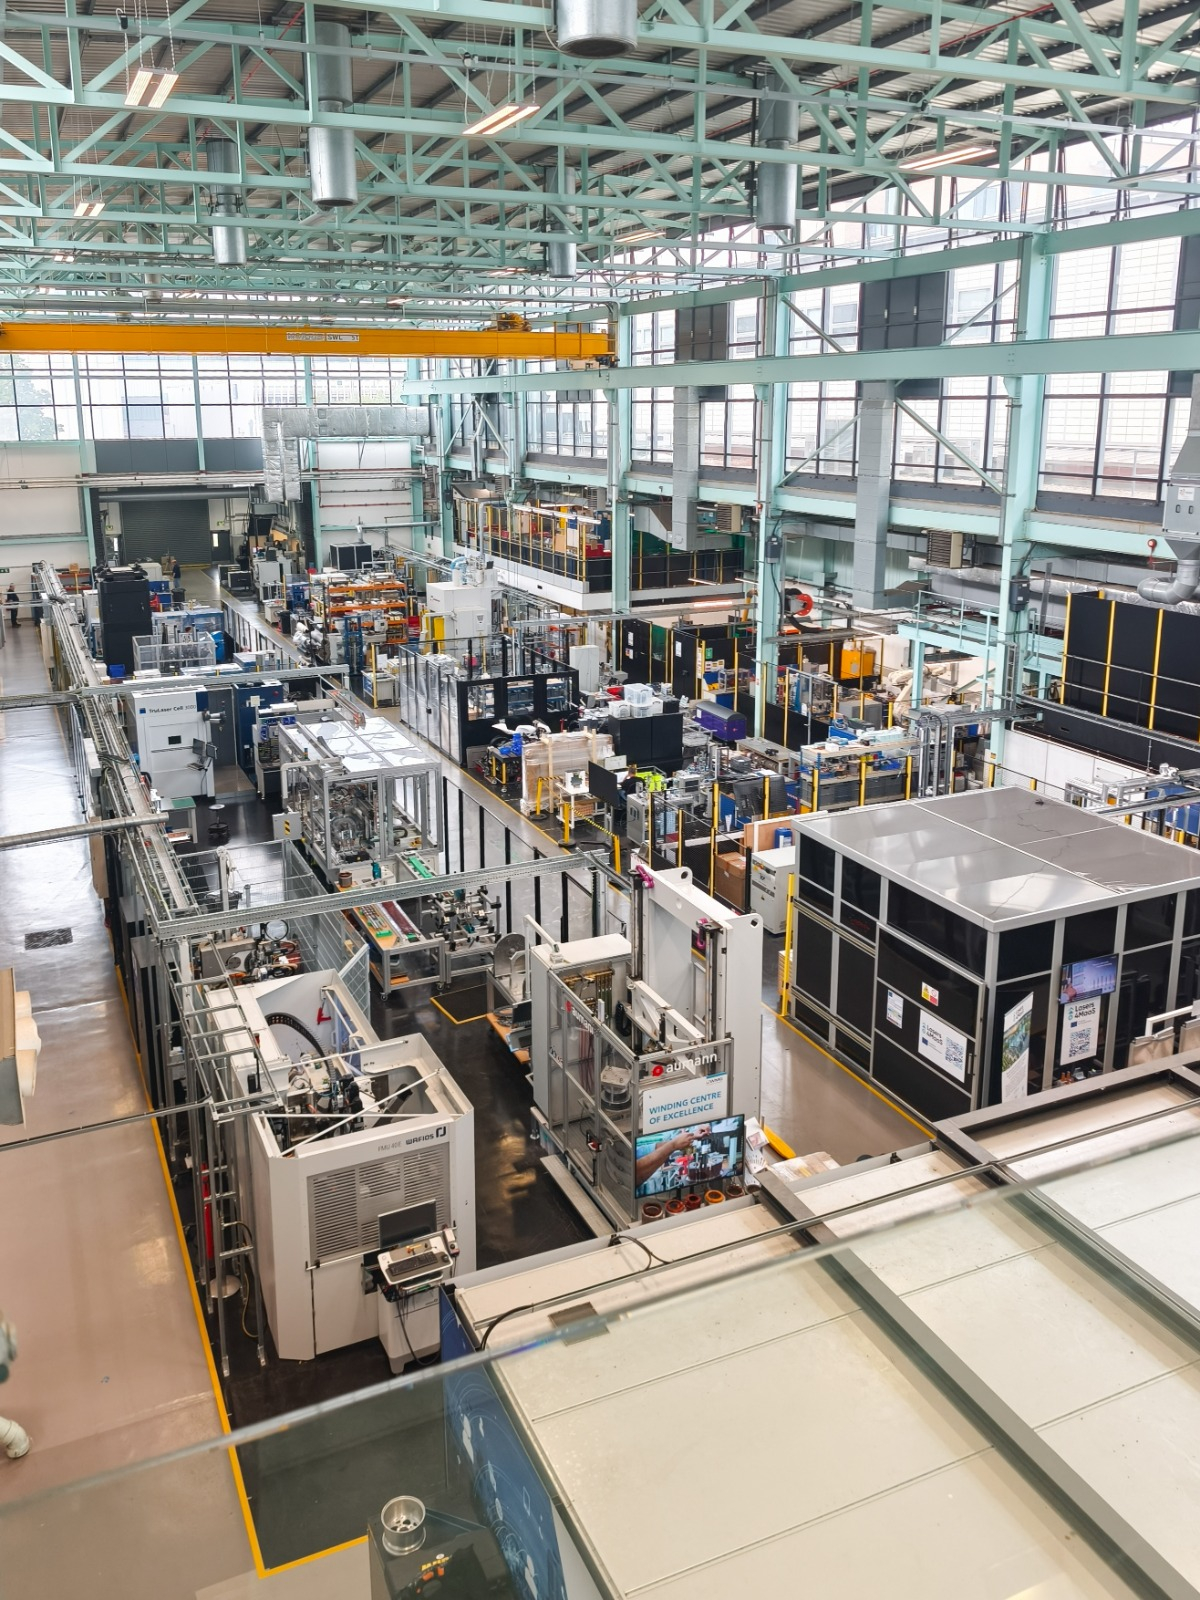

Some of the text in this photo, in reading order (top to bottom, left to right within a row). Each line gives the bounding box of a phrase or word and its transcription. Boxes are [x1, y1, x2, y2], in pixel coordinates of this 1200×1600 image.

[1074, 1008, 1096, 1019] 4MaaS
[1075, 1002, 1095, 1013] Lasers
[926, 1031, 943, 1046] 4MaaS
[927, 1024, 942, 1039] Lasers
[666, 1053, 718, 1074] aumann
[649, 1091, 722, 1115] WINDING CENTRE
[649, 1103, 714, 1125] OF EXCELLENCE
[405, 1133, 435, 1145] WAFIOS
